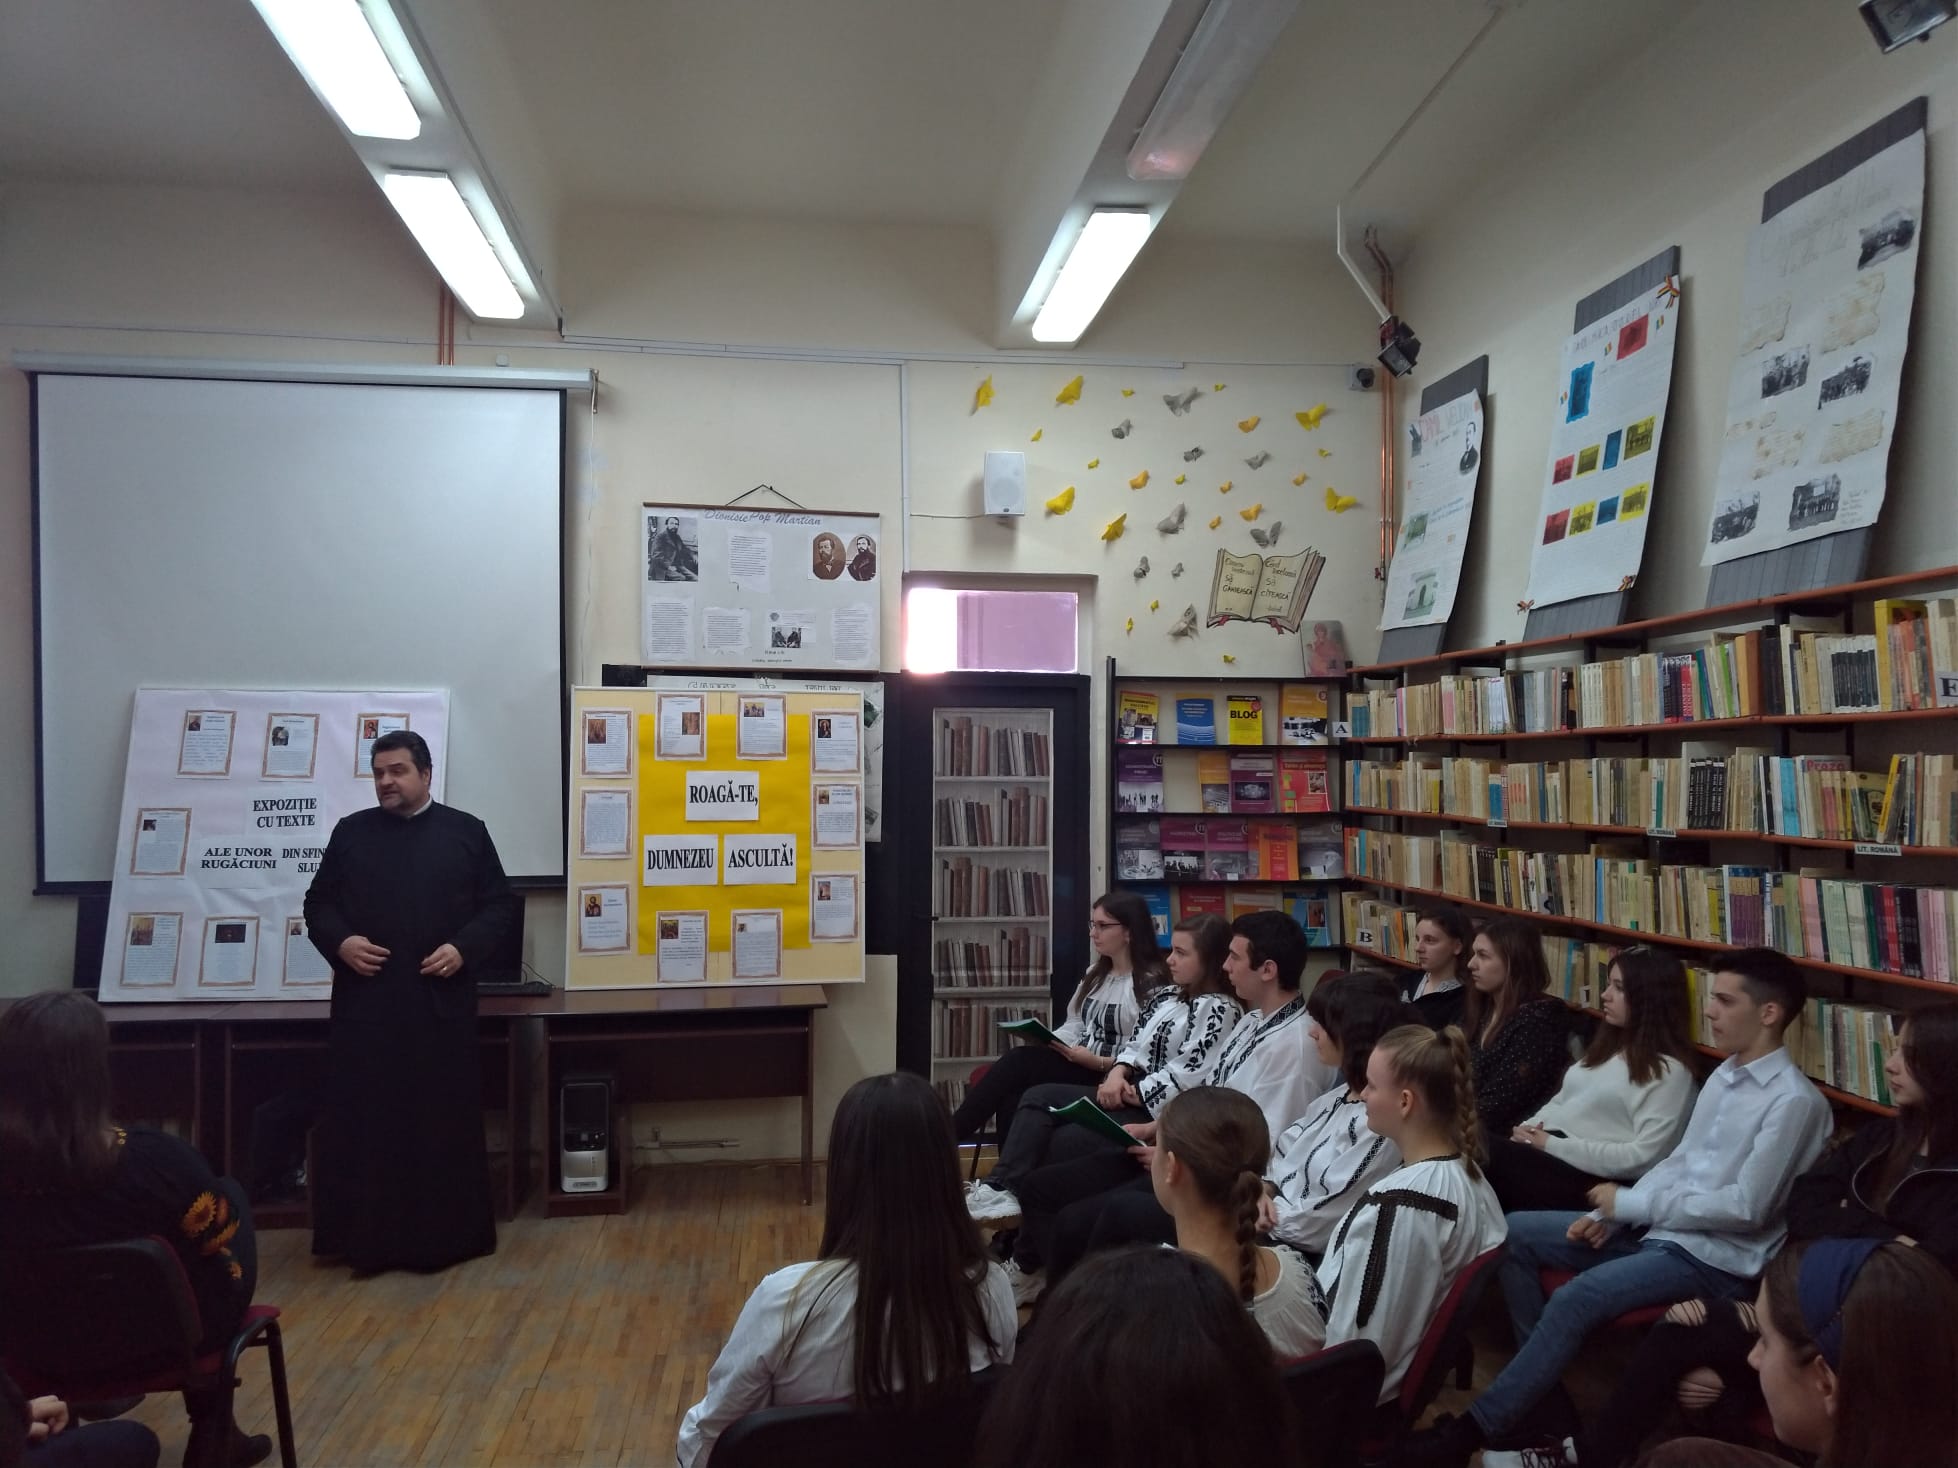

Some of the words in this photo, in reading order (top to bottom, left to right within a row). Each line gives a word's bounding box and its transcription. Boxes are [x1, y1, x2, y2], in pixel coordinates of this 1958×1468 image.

[775, 512, 821, 526] Martian
[1938, 677, 1958, 697] E
[1230, 710, 1258, 719] BLOG
[1335, 723, 1349, 734] A
[689, 779, 759, 806] ROAGĂ-TE,
[252, 797, 317, 813] EXPOZIȚIE
[256, 816, 274, 828] CU
[276, 814, 316, 827] TEXTE
[204, 847, 232, 857] ALE
[235, 847, 272, 857] UNOR
[281, 848, 301, 859] DIN
[647, 848, 714, 870] DUMNEZEU
[728, 843, 794, 868] ASCULTĂ!
[200, 857, 277, 869] RUGĂCIUNI
[1359, 931, 1374, 943] B
